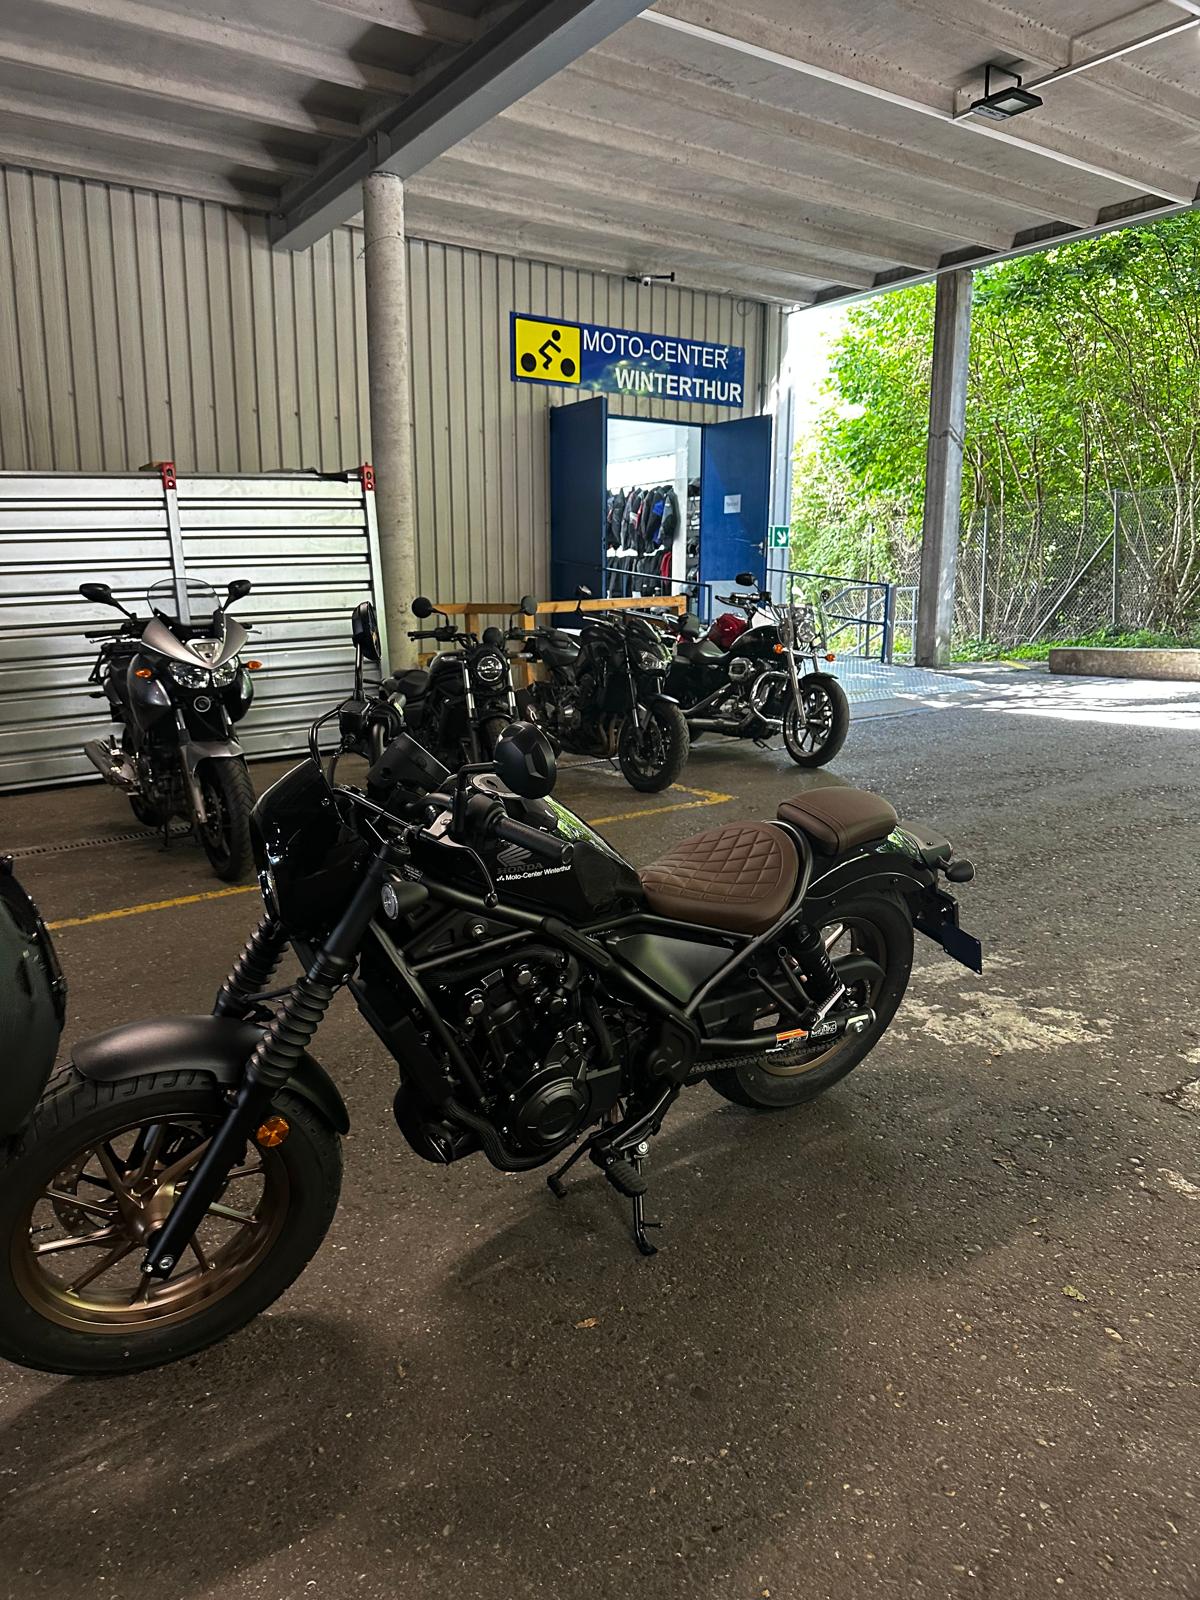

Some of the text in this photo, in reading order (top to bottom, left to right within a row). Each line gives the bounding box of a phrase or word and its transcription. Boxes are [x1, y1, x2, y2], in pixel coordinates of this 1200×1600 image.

[583, 329, 727, 370] MOTO-CENTER
[615, 367, 742, 403] WINTERTHUR
[497, 863, 544, 874] HONDA
[506, 865, 571, 880] Moto-Center Winterthur
